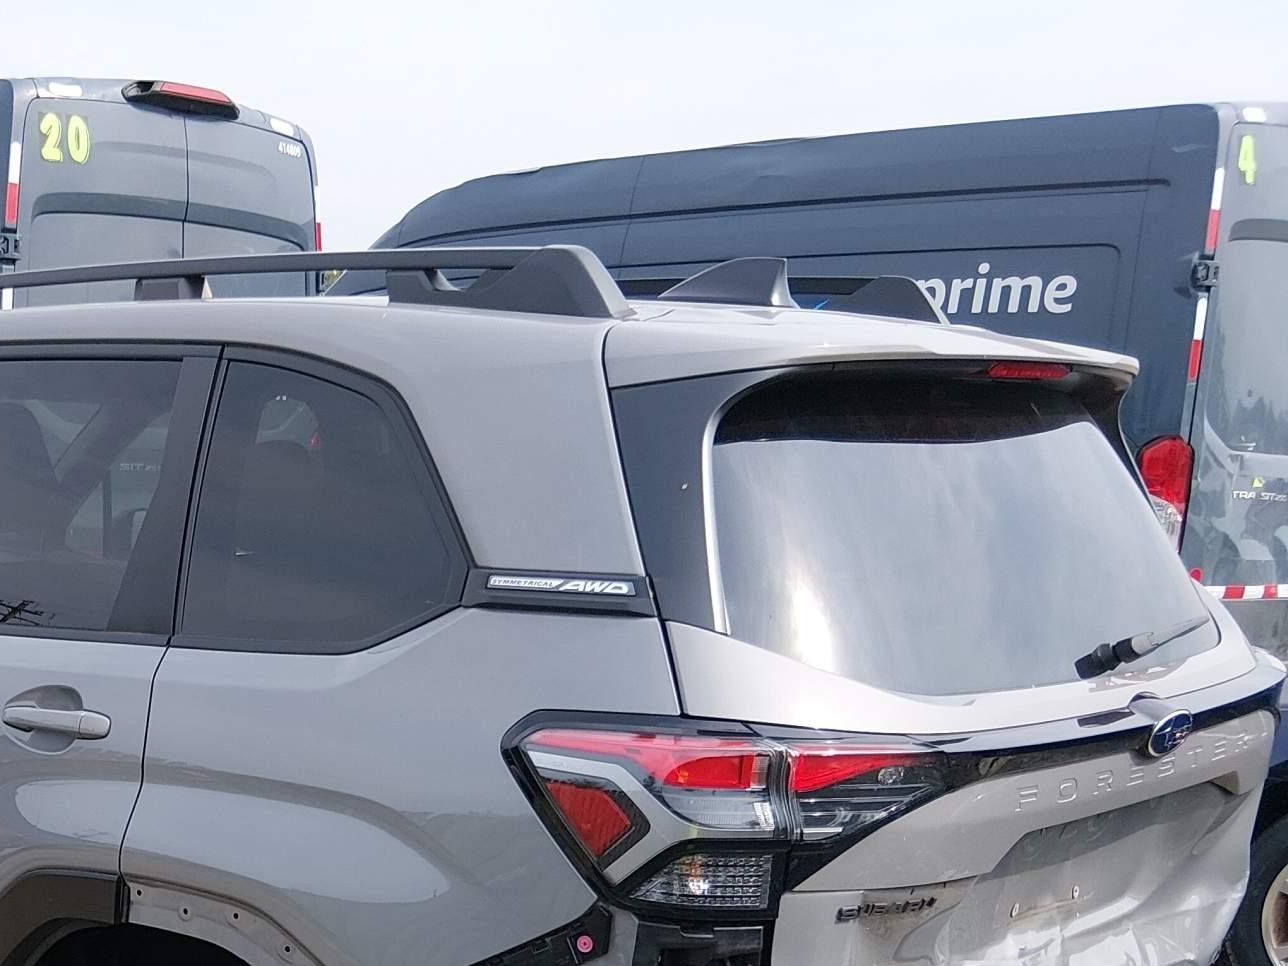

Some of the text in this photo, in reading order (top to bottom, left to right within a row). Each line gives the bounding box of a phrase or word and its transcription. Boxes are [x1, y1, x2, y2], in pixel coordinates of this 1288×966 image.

[40, 112, 91, 164] 20
[1238, 135, 1256, 184] 4
[916, 262, 1078, 314] prime
[491, 578, 630, 594] SYMMETRICAL AWD
[1014, 729, 1252, 813] FORESTER
